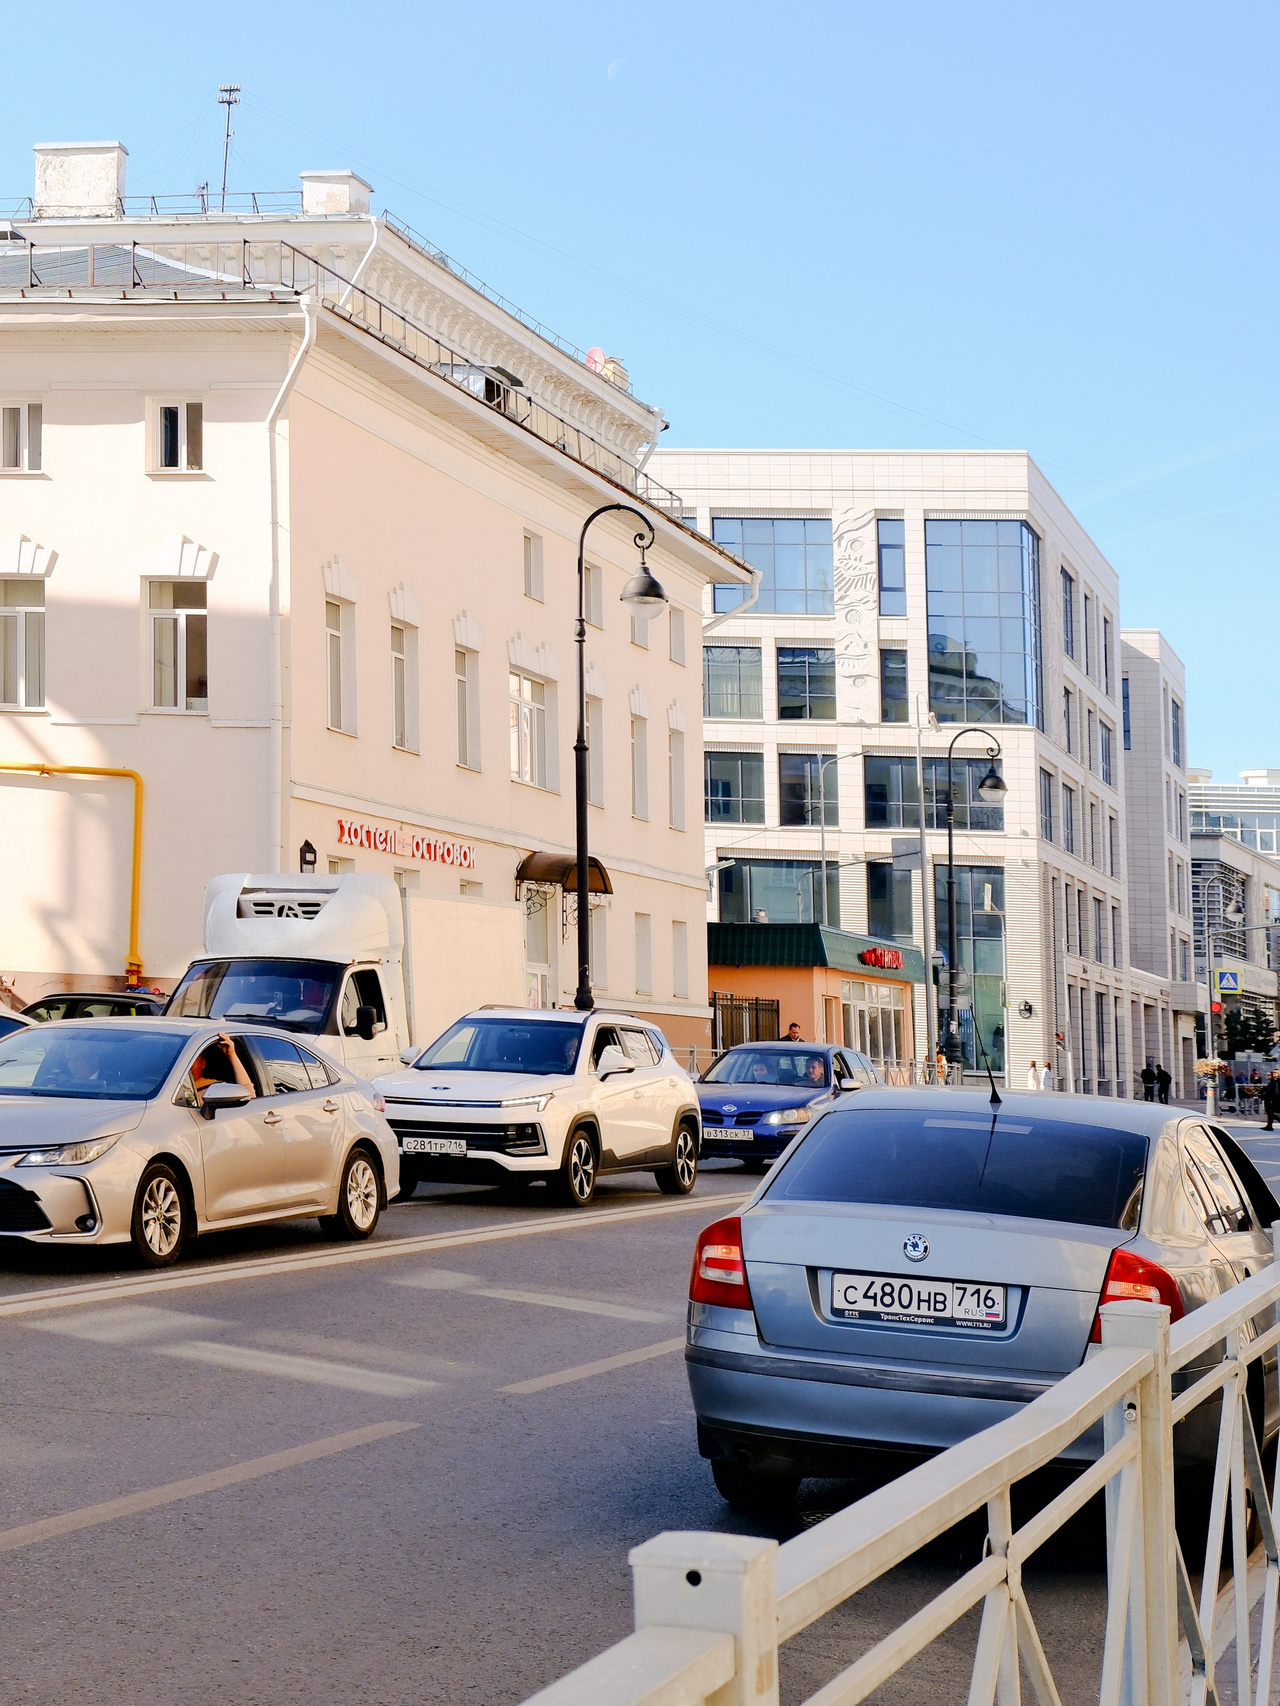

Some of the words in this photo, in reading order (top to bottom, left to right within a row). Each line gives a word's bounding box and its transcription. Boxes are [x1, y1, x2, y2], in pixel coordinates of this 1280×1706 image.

[406, 1139, 446, 1151] С281ТР
[448, 1140, 463, 1150] 716
[843, 1280, 948, 1314] С480НВ
[955, 1286, 997, 1310] 716
[880, 1313, 935, 1325] ТрансТехСервис
[964, 1308, 985, 1318] RUS
